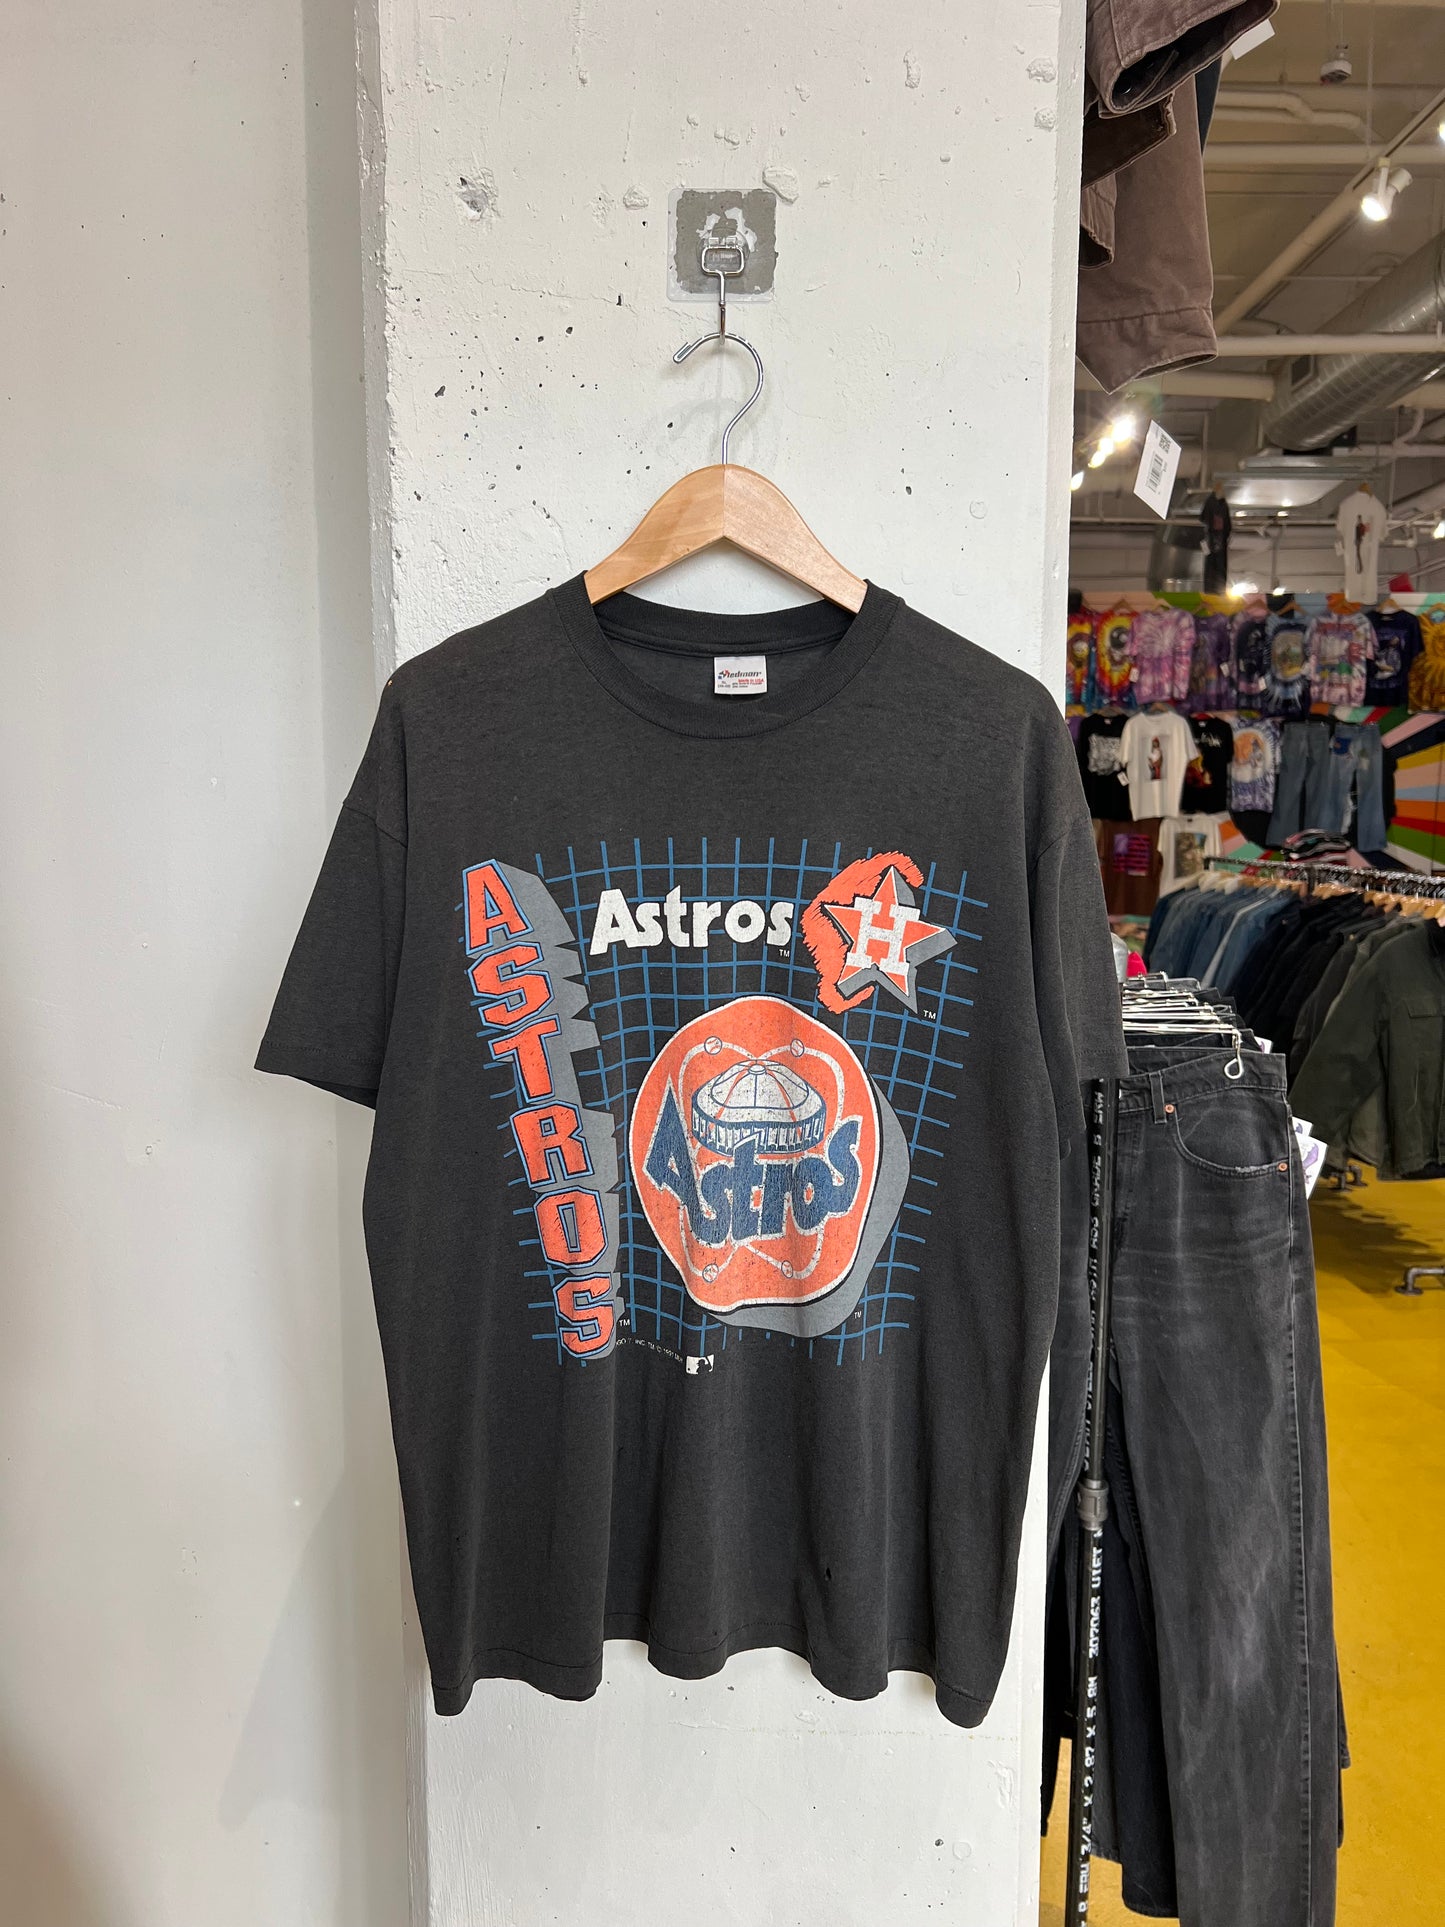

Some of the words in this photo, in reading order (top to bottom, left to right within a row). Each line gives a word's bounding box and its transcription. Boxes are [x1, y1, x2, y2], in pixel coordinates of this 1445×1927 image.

[589, 884, 795, 956] Astros
[778, 948, 791, 958] TM
[846, 896, 921, 977] H
[923, 1009, 936, 1020] TM
[462, 859, 614, 1357] ASTROS
[643, 1077, 863, 1247] Astros
[619, 1318, 631, 1327] TM
